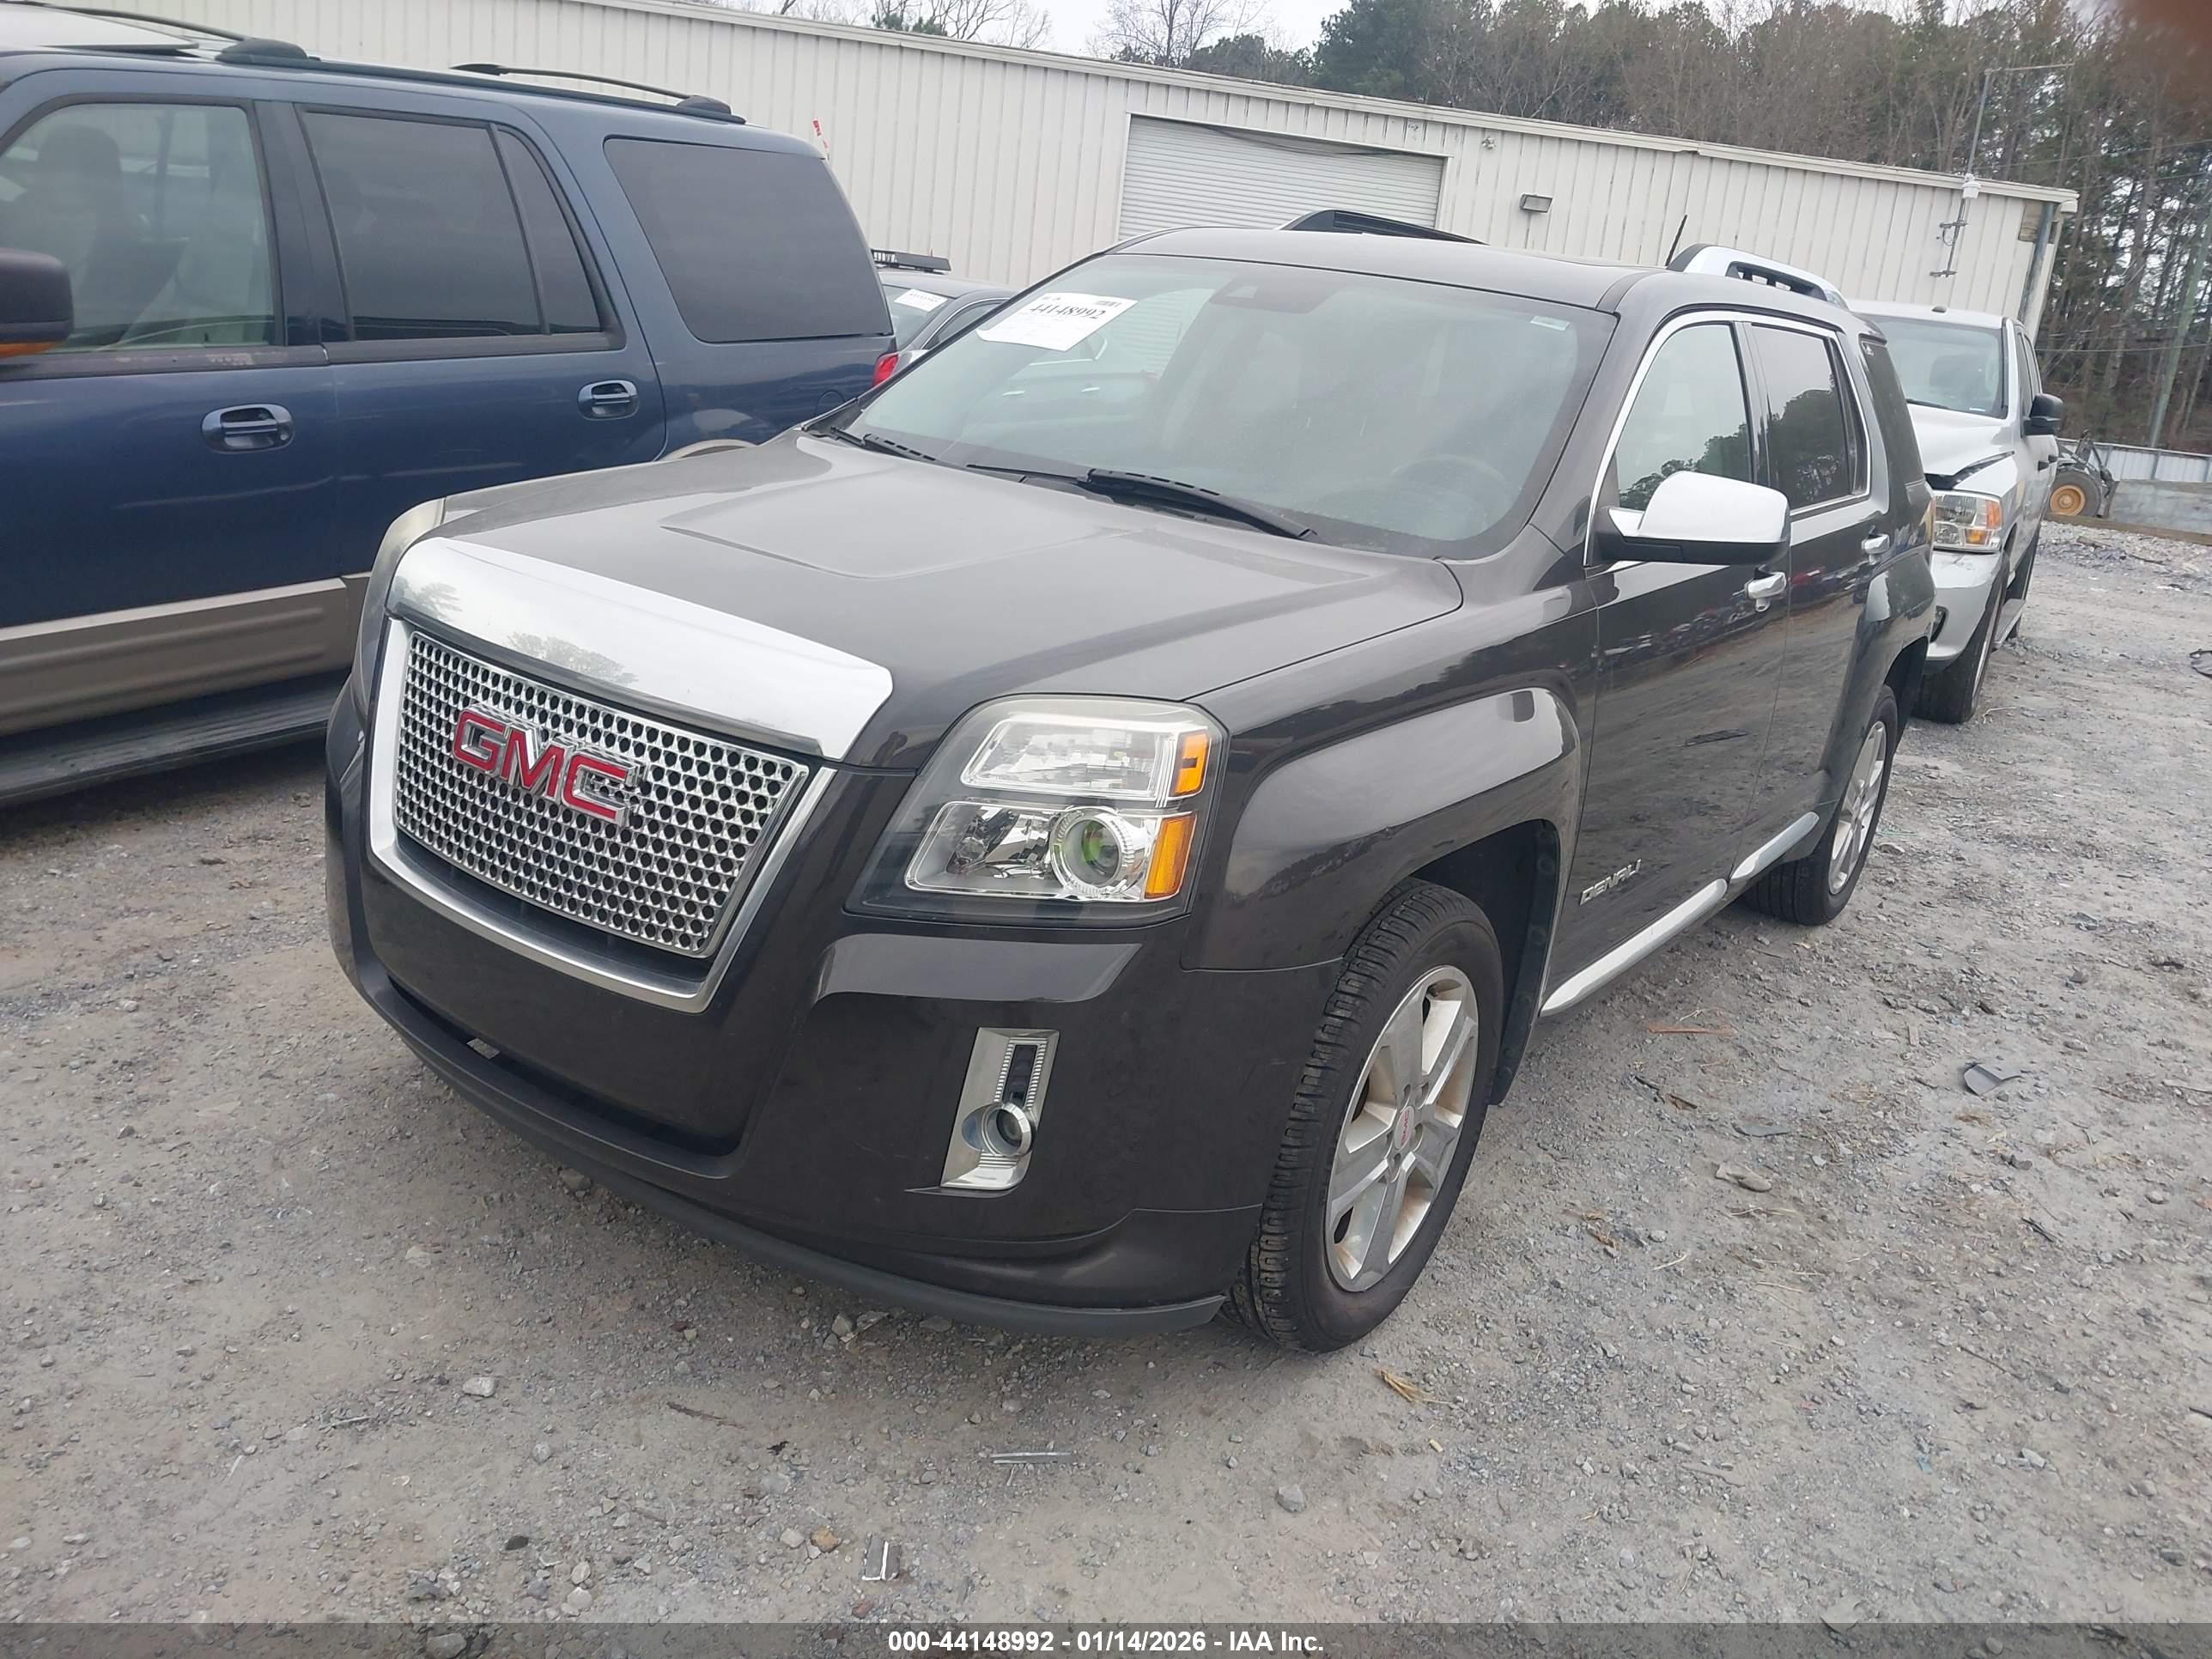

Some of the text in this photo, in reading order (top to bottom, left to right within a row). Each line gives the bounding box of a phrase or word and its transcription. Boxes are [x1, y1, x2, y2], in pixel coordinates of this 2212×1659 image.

[1029, 303, 1107, 319] 44148992
[453, 704, 635, 824] GMC
[1579, 858, 1642, 906] DENALI
